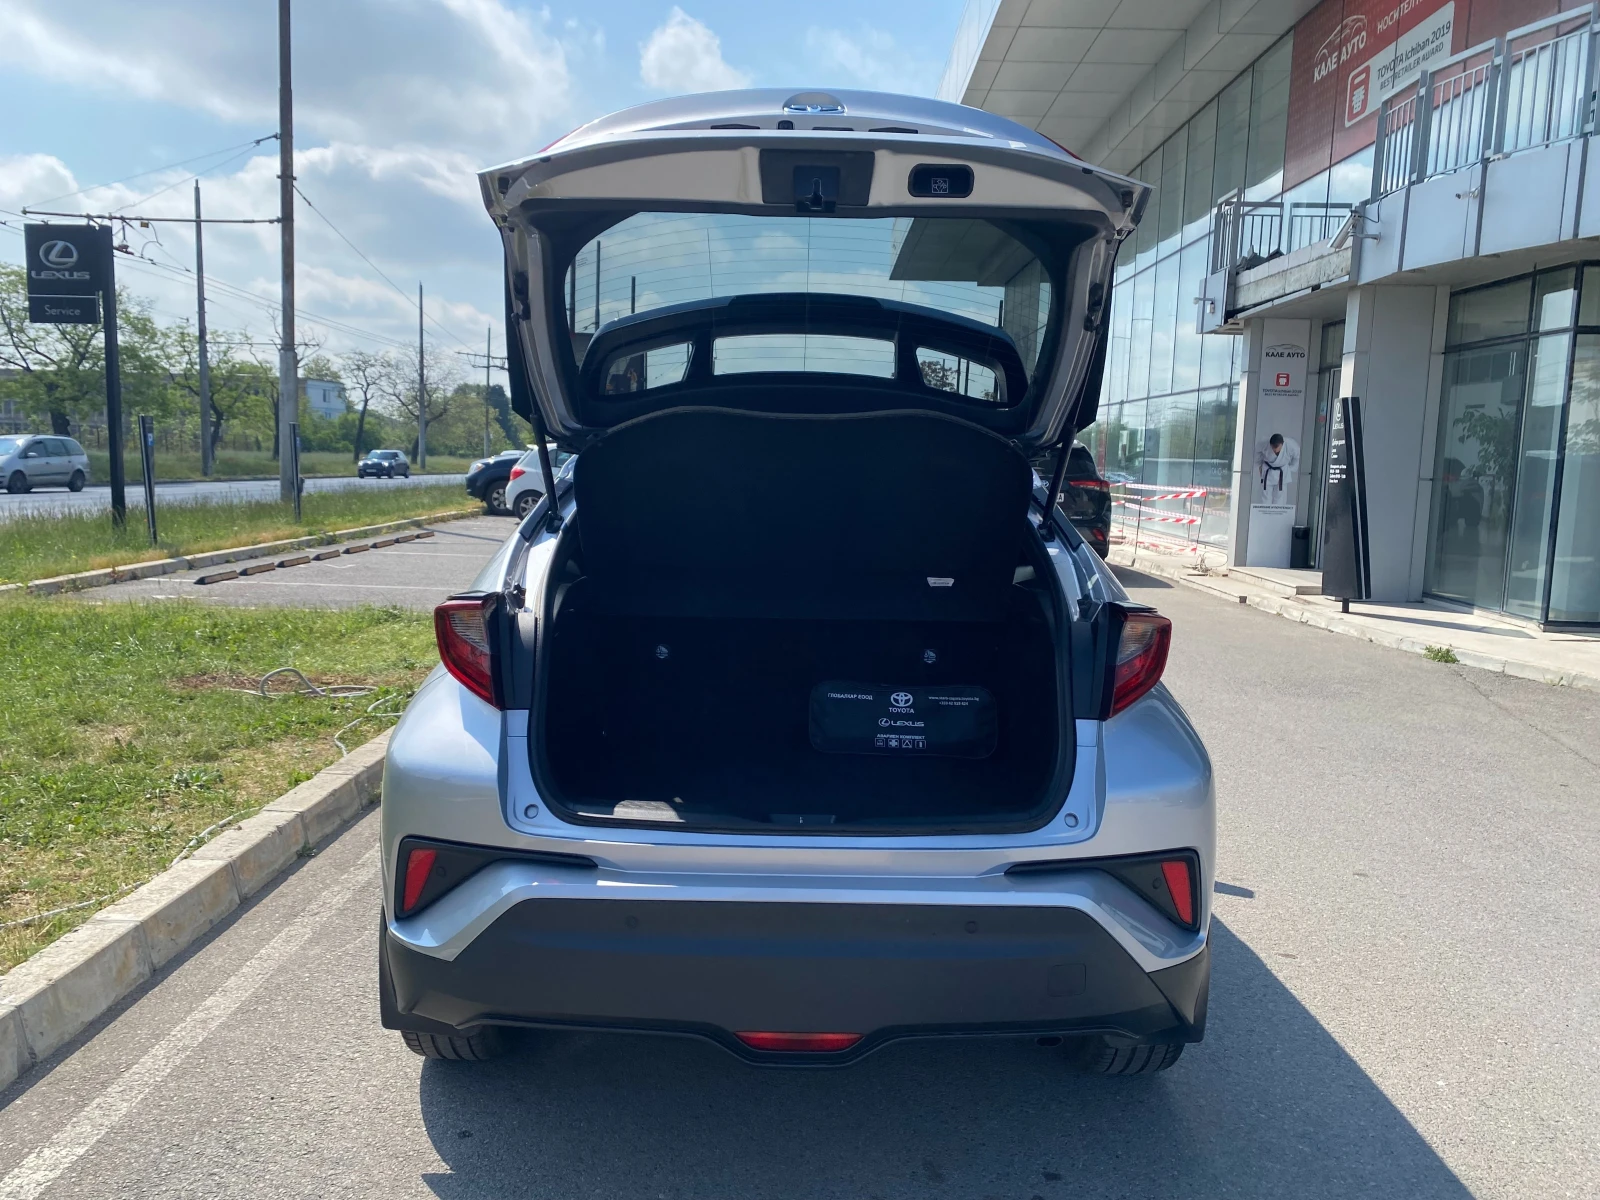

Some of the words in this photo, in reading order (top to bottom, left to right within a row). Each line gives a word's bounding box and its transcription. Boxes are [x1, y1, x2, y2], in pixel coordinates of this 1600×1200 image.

[1313, 51, 1338, 84] КАЛЕ
[1340, 30, 1367, 65] АУТО
[1377, 52, 1404, 80] TOYOTA
[1405, 37, 1430, 62] Ichiban
[1431, 20, 1451, 44] 2019
[1421, 41, 1444, 63] AWARD
[31, 270, 91, 280] LEXUS
[44, 304, 80, 316] Service
